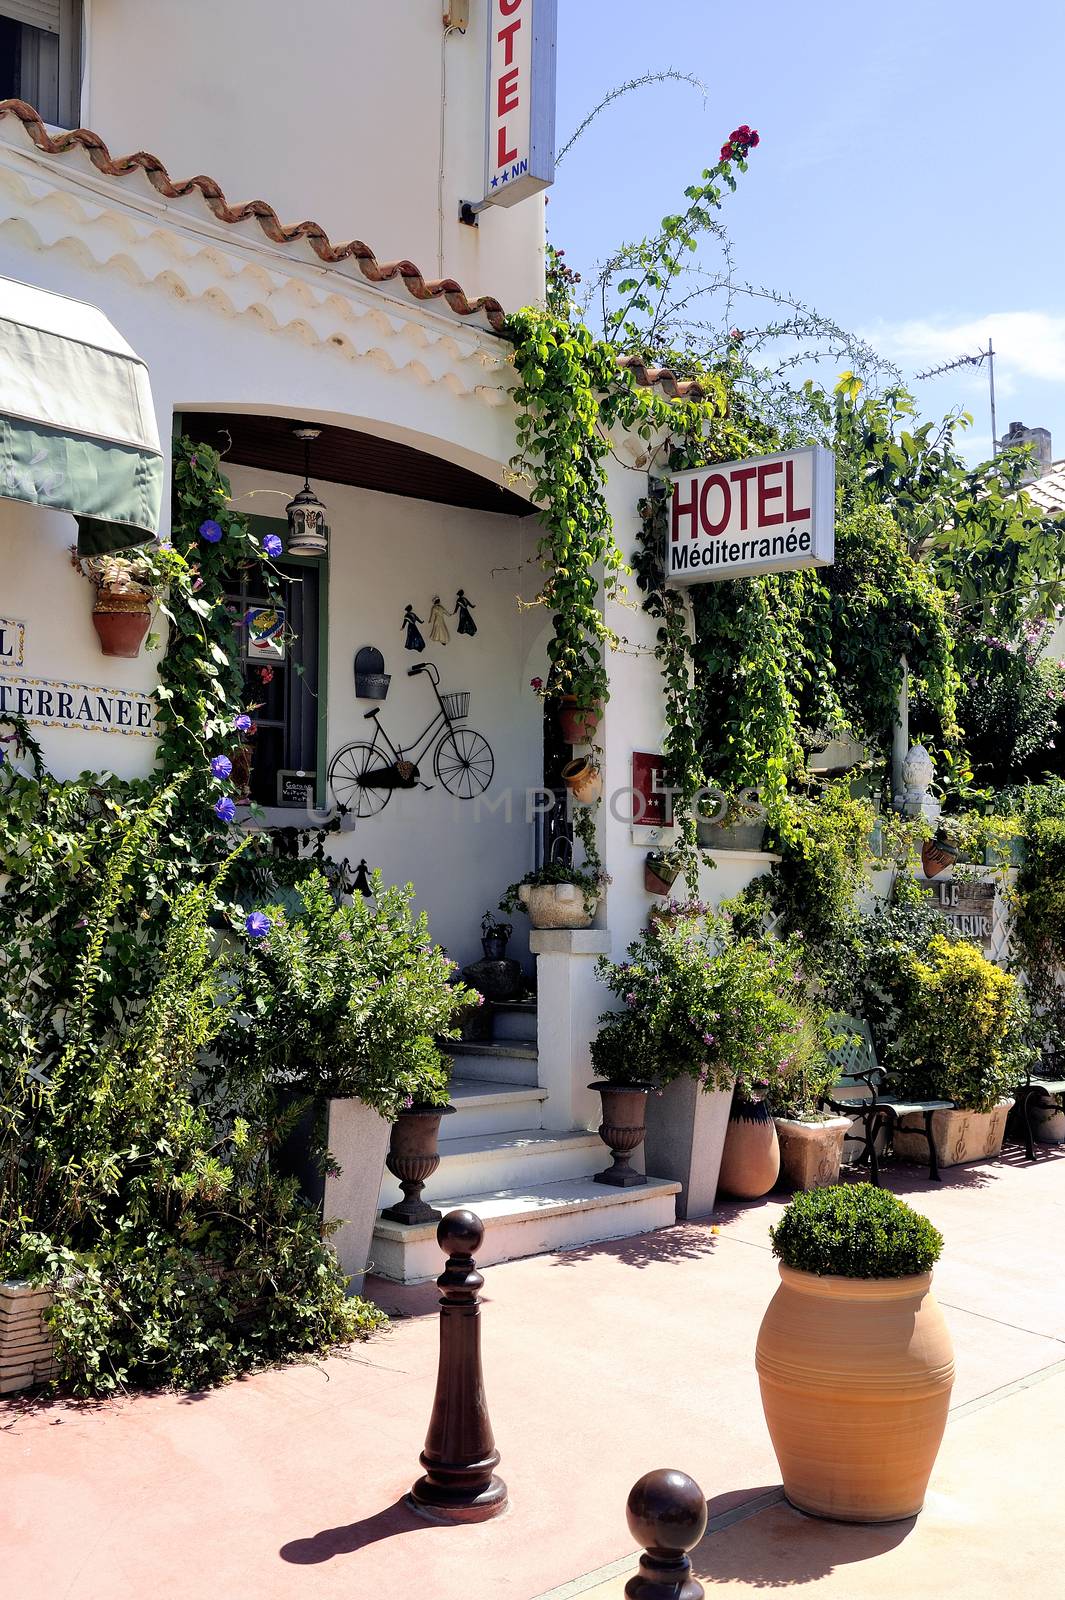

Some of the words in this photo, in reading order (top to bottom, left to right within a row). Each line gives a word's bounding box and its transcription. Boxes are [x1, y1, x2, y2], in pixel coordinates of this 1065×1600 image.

[512, 159, 528, 178] NN
[672, 460, 811, 542] HOTEL
[671, 527, 811, 571] Méditerranée
[941, 883, 960, 907] LE
